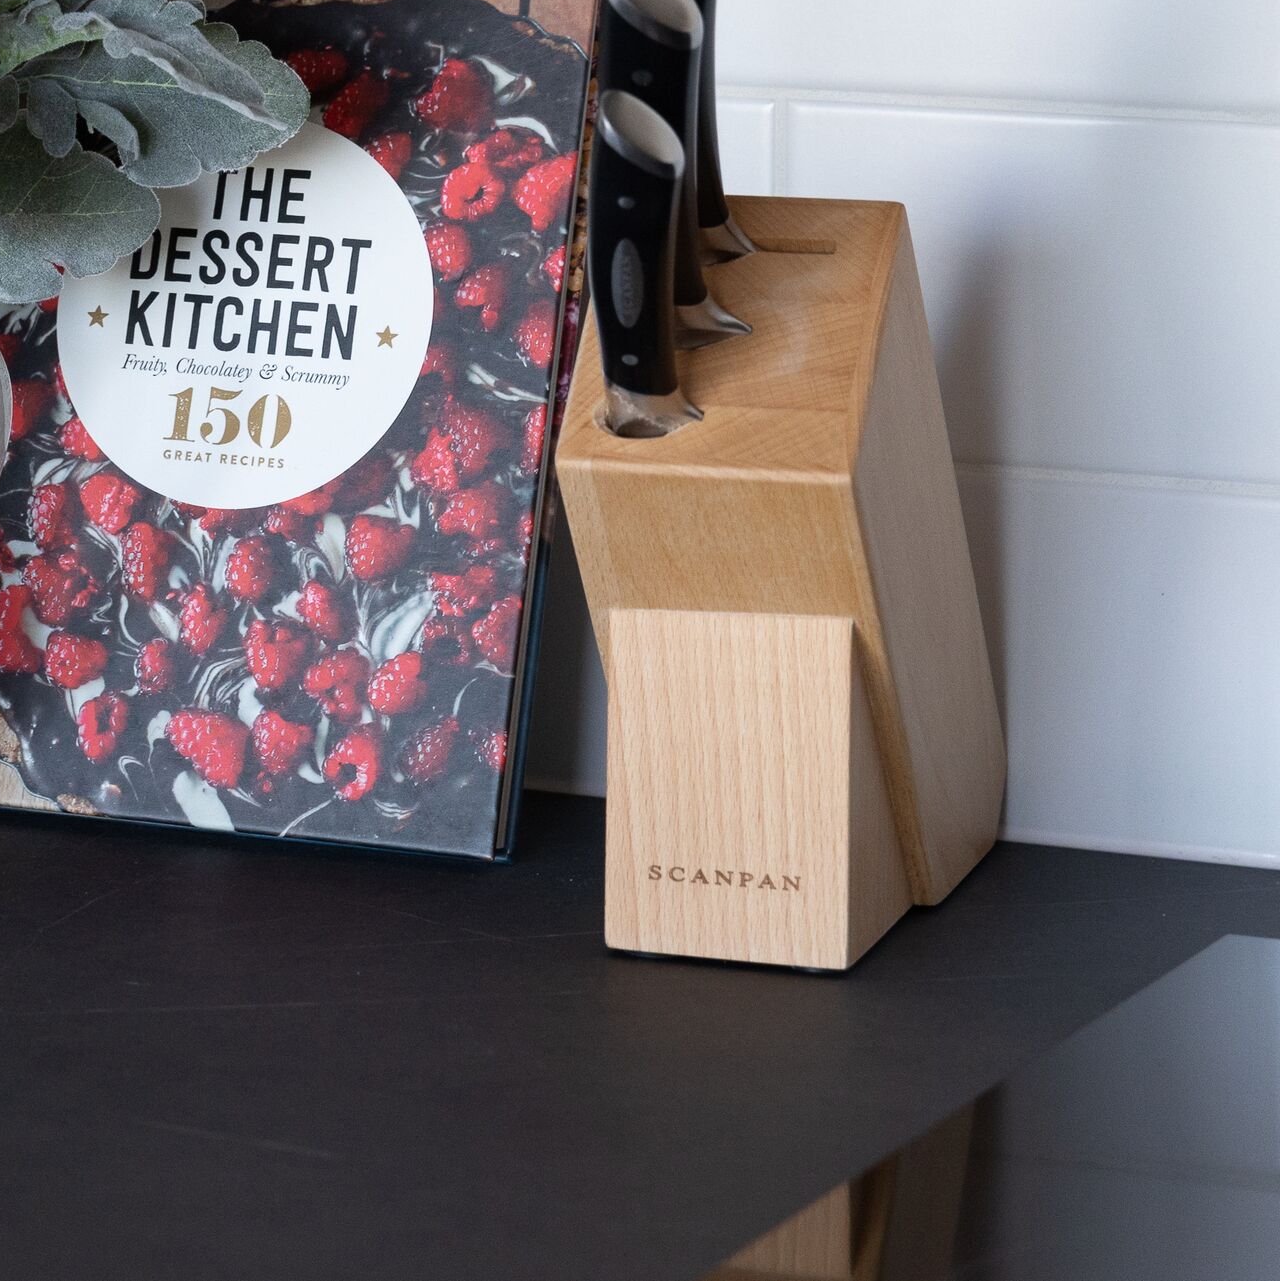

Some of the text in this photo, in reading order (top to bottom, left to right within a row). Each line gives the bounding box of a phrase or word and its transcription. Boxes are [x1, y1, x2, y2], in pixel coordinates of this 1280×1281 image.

[212, 167, 312, 224] THE
[129, 226, 372, 295] DESSERT
[124, 289, 358, 361] KITCHEN
[121, 353, 351, 391] Fruity, Chocolatey & Scrummy
[162, 386, 292, 449] 150
[162, 449, 285, 470] GREAT RECIPES
[648, 865, 801, 892] SCANPAN
